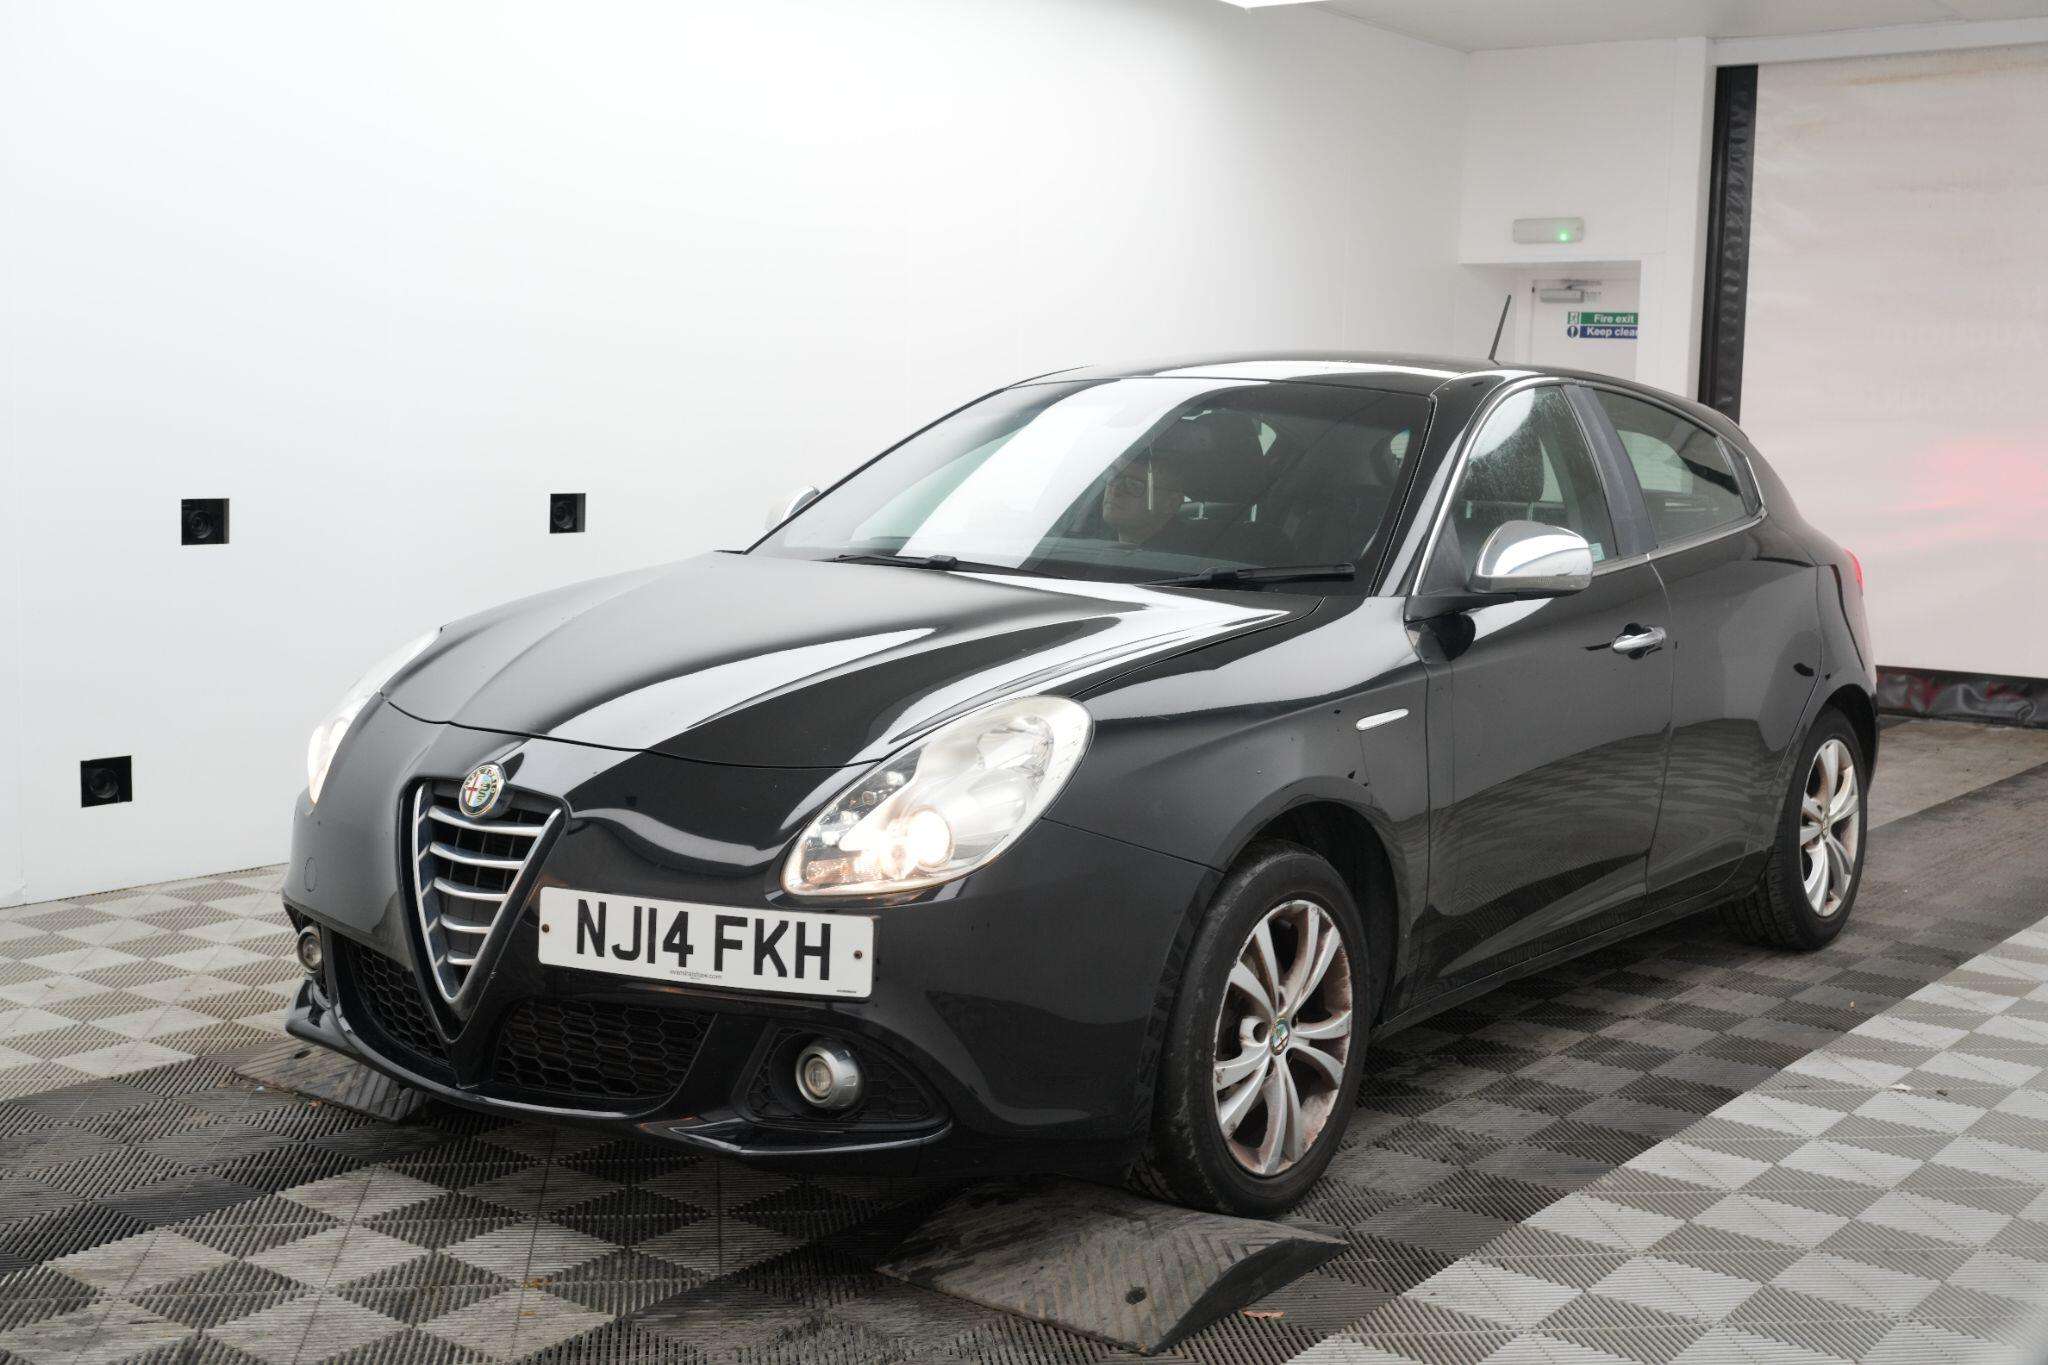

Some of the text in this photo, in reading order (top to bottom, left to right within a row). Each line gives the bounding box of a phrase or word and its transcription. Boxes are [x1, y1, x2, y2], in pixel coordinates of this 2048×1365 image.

[1594, 314, 1634, 323] Fire exit
[1587, 326, 1612, 338] Keep
[576, 898, 831, 980] NJ14 FKH
